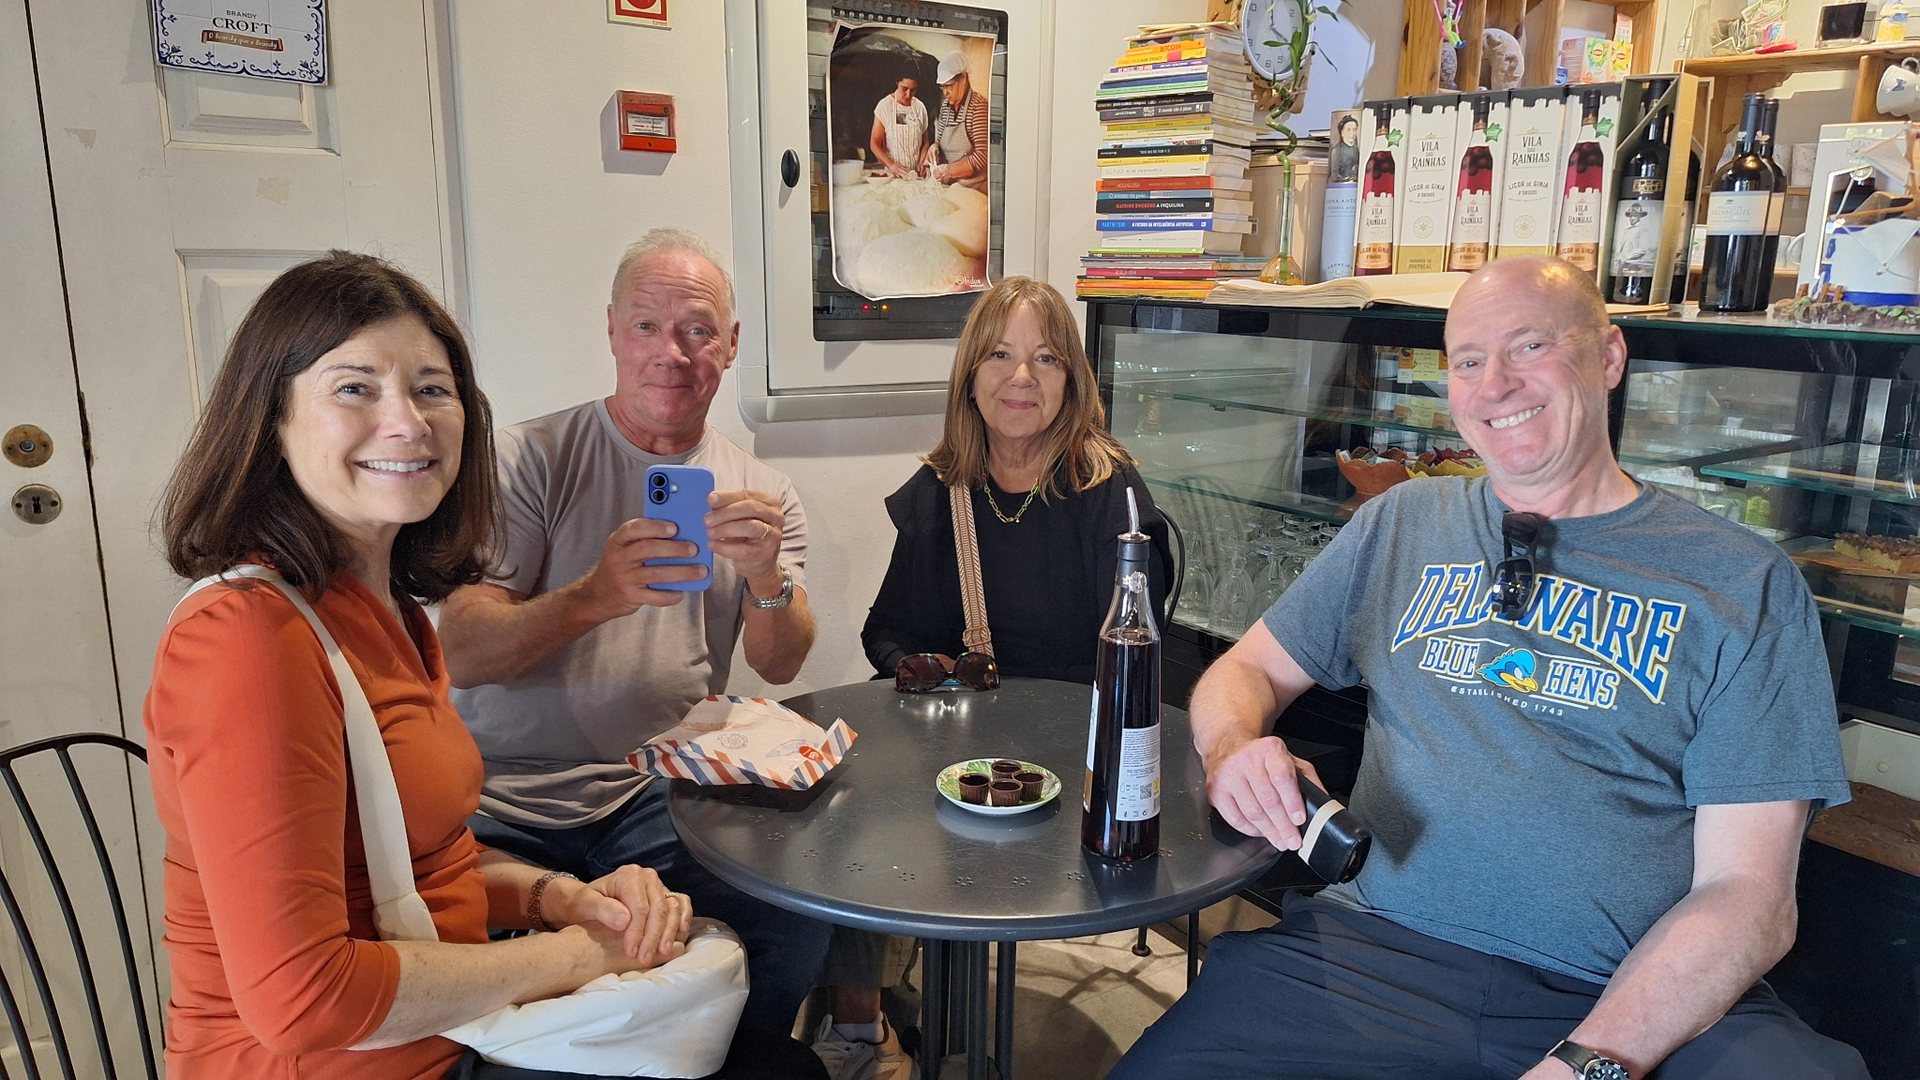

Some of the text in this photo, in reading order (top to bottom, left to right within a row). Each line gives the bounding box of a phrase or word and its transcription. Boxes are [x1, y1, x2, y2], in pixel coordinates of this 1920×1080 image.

[226, 9, 257, 19] BRANDY
[1289, 9, 1295, 18] 2
[212, 17, 272, 35] CROFT
[1256, 53, 1261, 61] 7
[1277, 56, 1284, 64] 5
[1265, 60, 1272, 68] 6
[1421, 140, 1440, 152] VILA
[1522, 136, 1542, 148] VILA
[1411, 156, 1446, 170] RAINHAS
[1512, 152, 1550, 167] RAINHAS
[1408, 183, 1424, 193] LICOR
[1431, 183, 1446, 192] GINJA
[1508, 180, 1525, 190] LICOR
[1533, 180, 1550, 189] GINJA
[1371, 208, 1383, 216] VILA
[1466, 206, 1479, 214] VILA
[1574, 204, 1588, 213] VILA
[1568, 215, 1593, 225] RAINHAS
[1418, 637, 1619, 709] BLUE HENS
[1450, 685, 1563, 717] ESTABLISHED 1743
